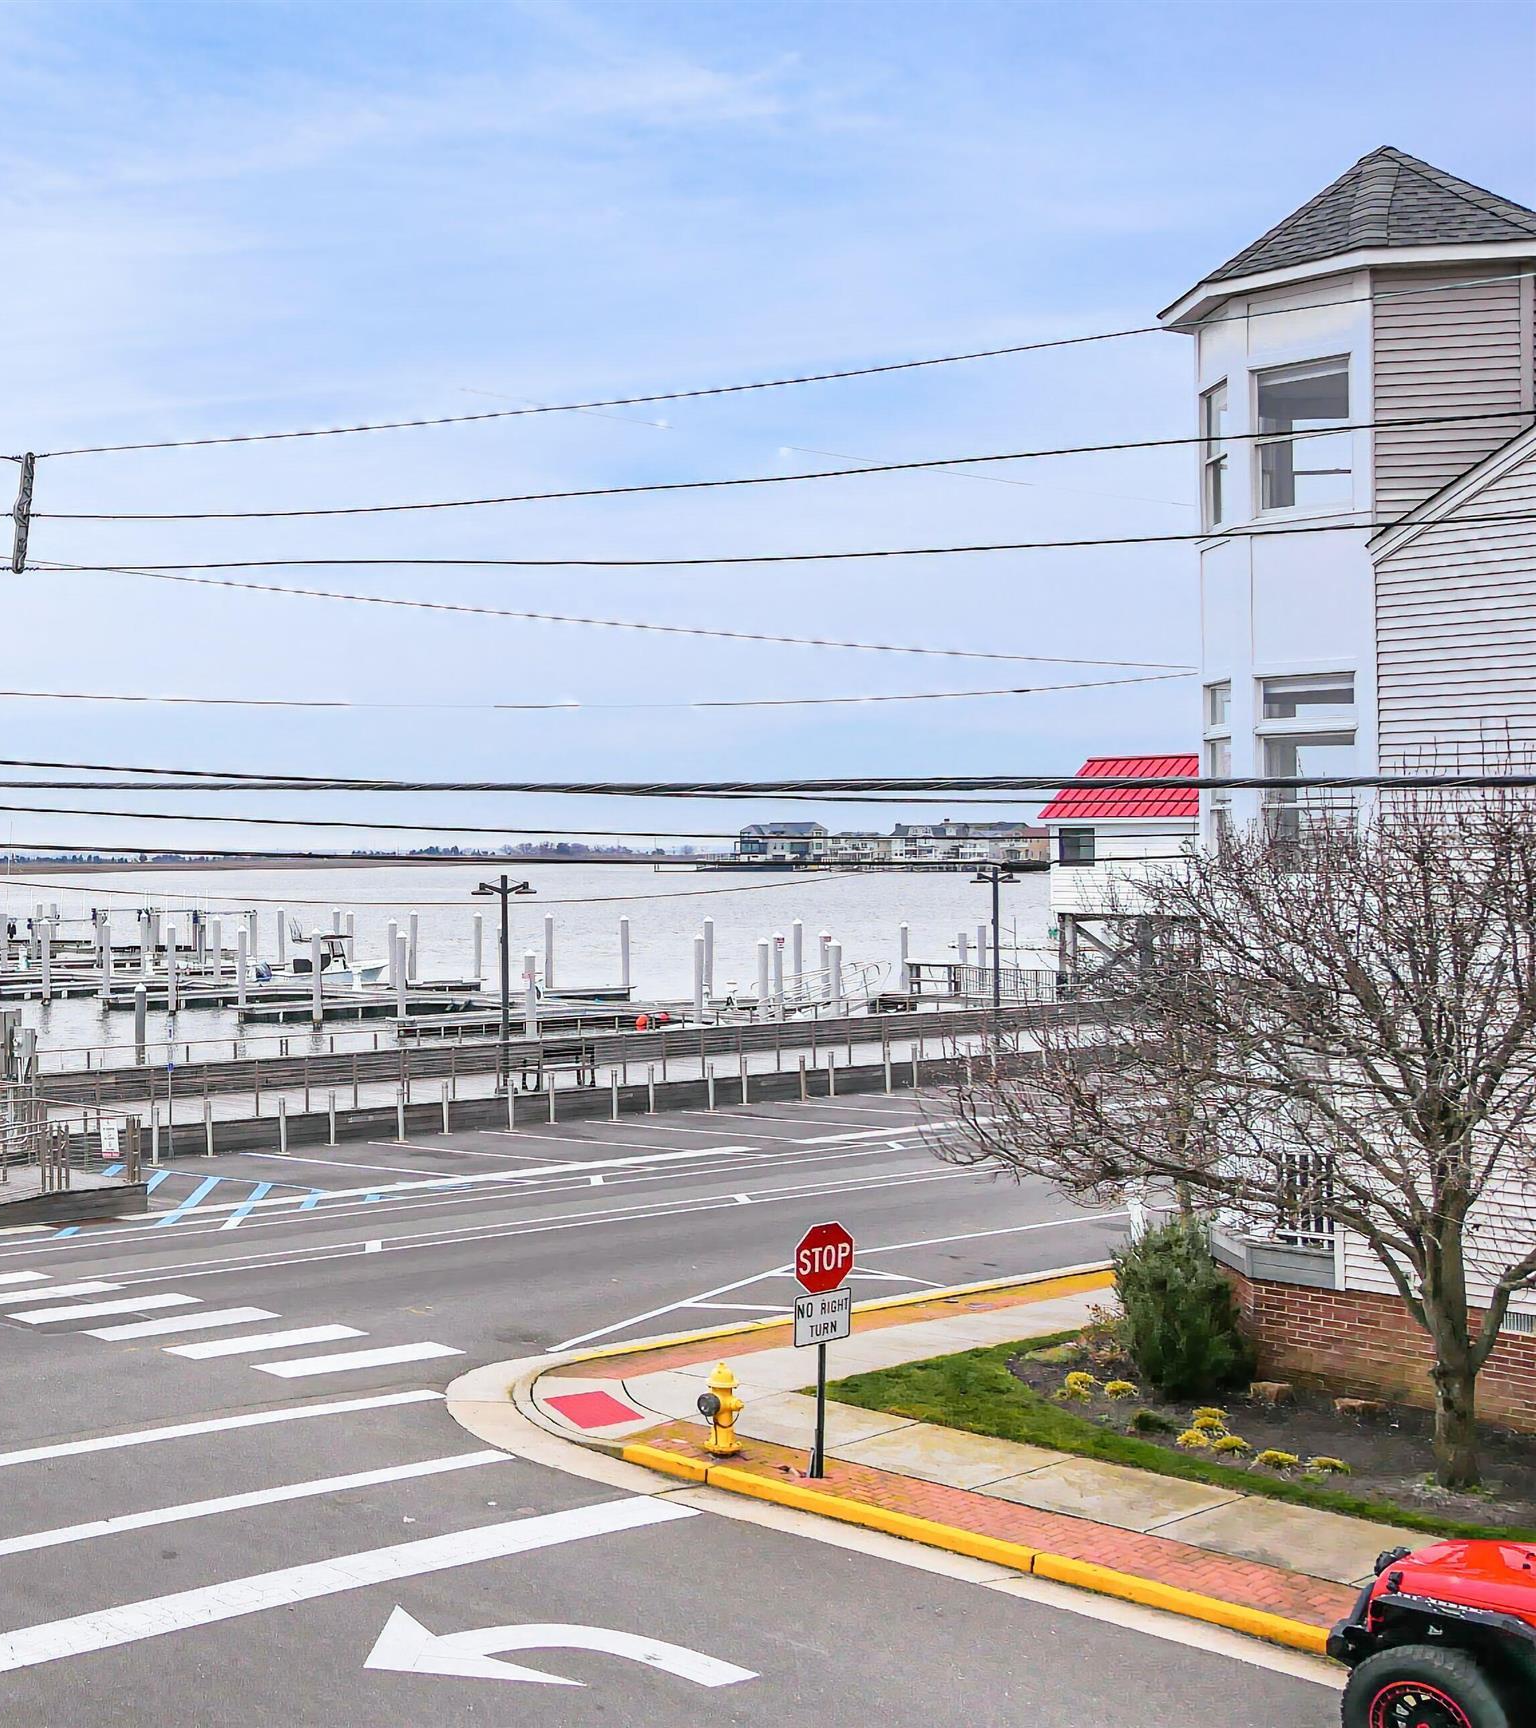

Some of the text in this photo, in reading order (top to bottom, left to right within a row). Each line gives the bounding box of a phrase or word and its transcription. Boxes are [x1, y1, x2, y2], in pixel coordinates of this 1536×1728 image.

[798, 1242, 850, 1275] STOP
[797, 1297, 849, 1320] NO RIGHT
[810, 1320, 837, 1337] TURN
